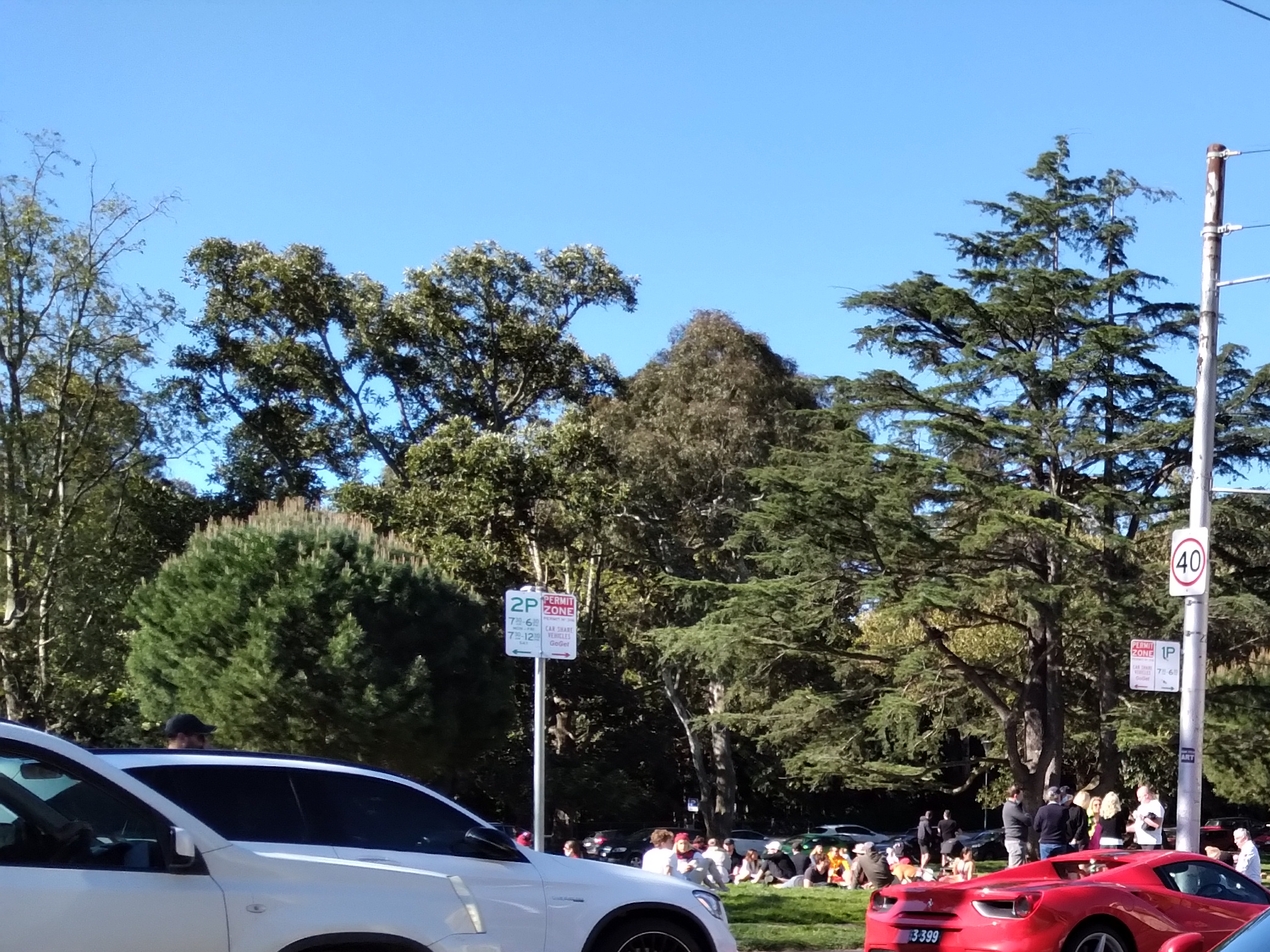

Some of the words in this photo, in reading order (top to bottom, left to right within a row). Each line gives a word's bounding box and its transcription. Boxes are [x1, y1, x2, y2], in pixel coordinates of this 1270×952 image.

[1176, 550, 1200, 573] 40
[511, 597, 538, 612] 2P
[544, 596, 574, 605] PERMIT
[544, 606, 574, 616] ZONE
[1132, 649, 1154, 658] ZONE
[1162, 646, 1176, 660] 1P
